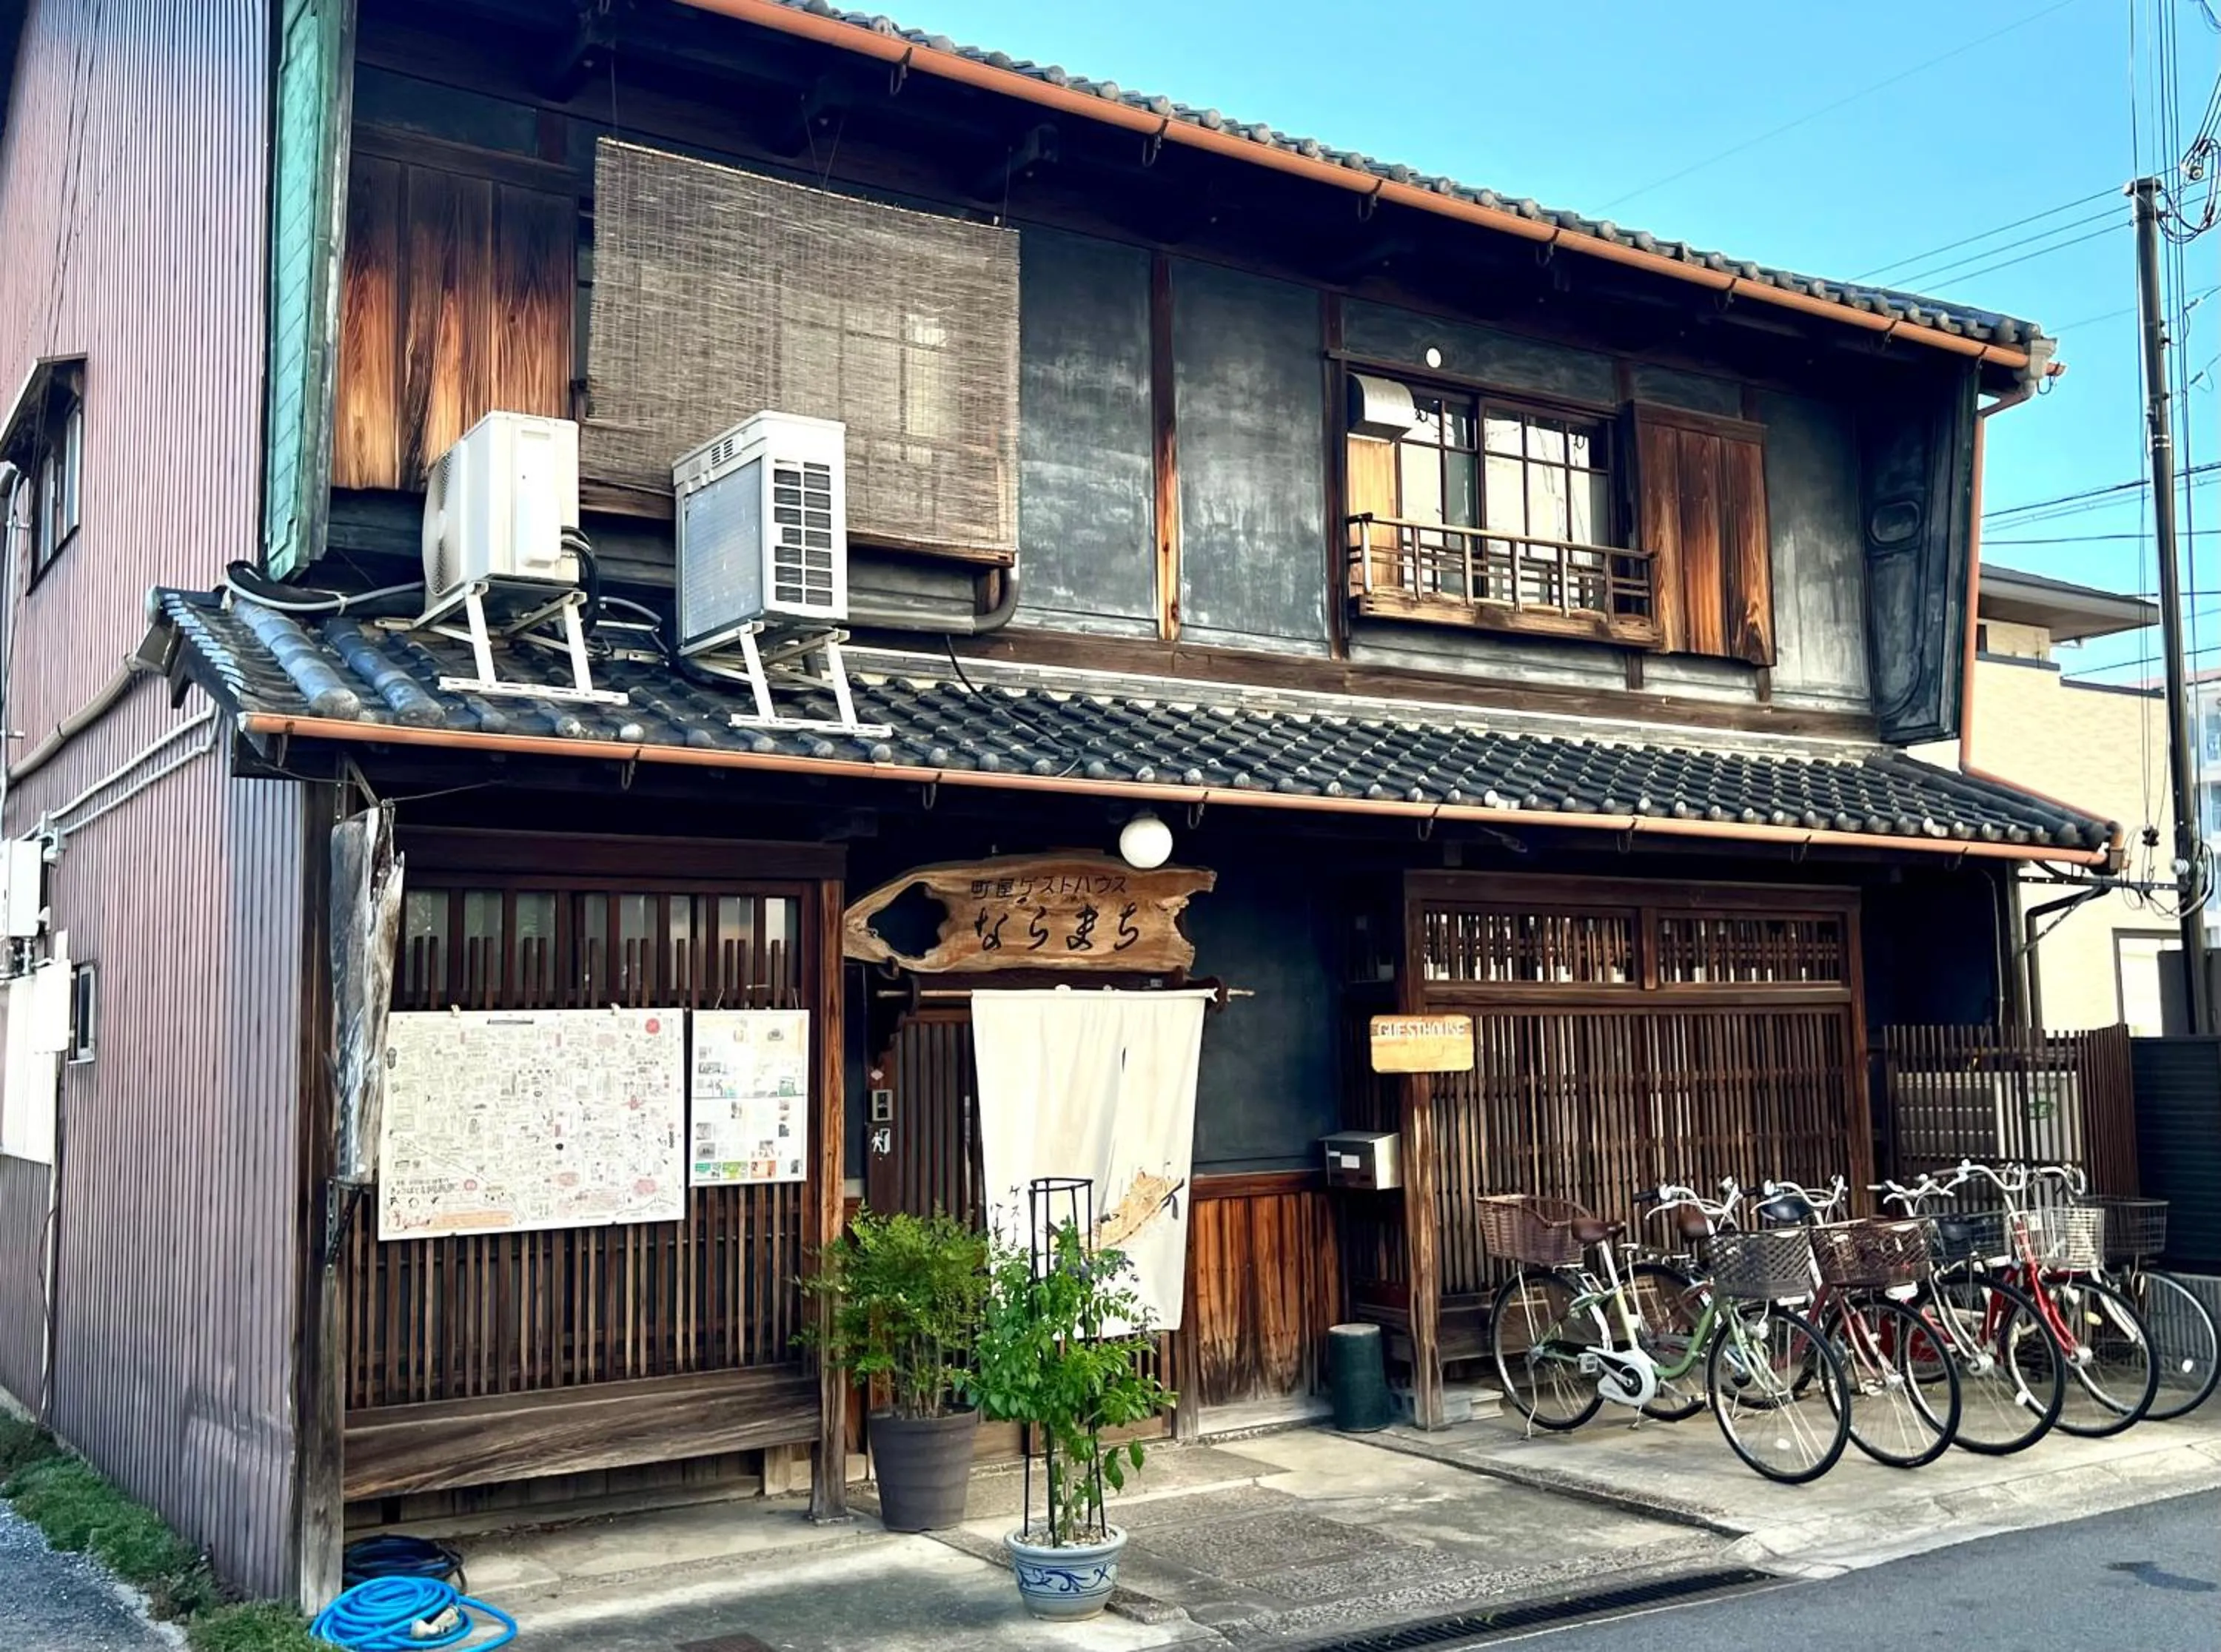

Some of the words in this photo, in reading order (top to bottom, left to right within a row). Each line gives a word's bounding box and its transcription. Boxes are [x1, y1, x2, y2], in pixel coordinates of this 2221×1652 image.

[971, 876, 1127, 899] 町屋ゲストハウス
[974, 901, 1139, 951] ならまち
